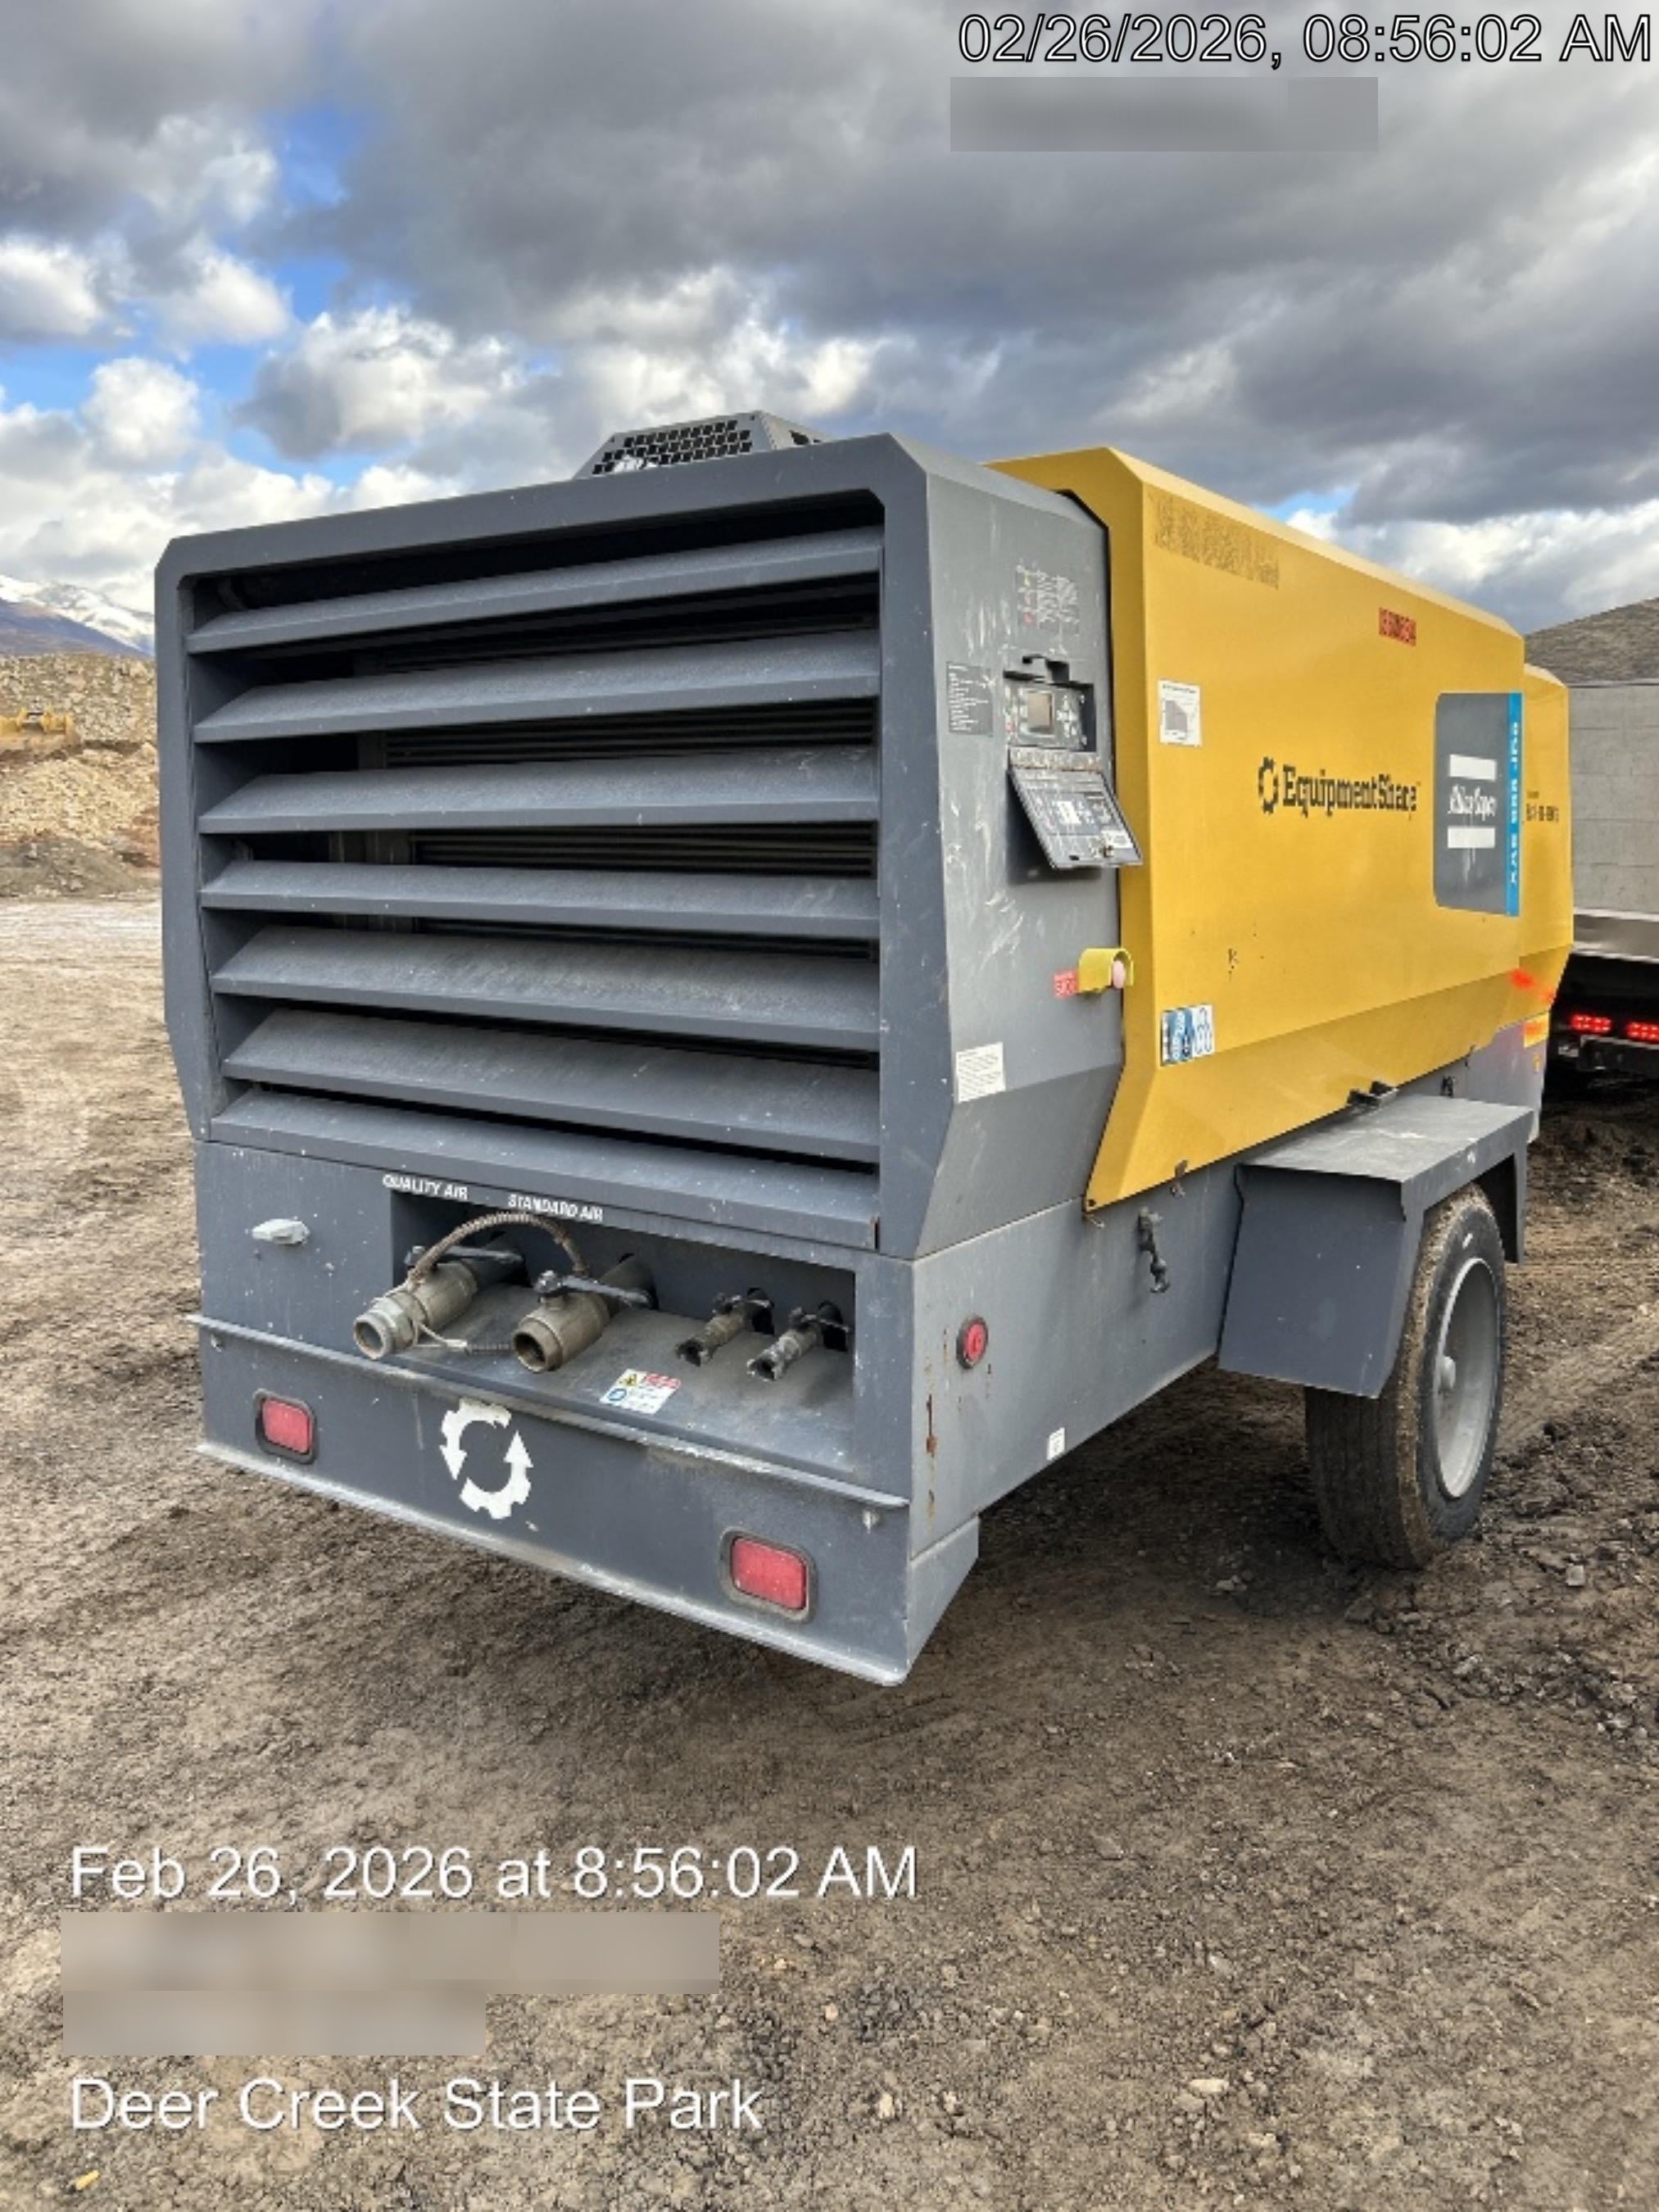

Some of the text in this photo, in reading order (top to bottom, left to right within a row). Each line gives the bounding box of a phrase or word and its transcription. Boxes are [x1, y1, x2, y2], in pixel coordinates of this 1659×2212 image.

[382, 1174, 468, 1201] QUALITY AIR
[508, 1194, 604, 1222] STANDARD AIR
